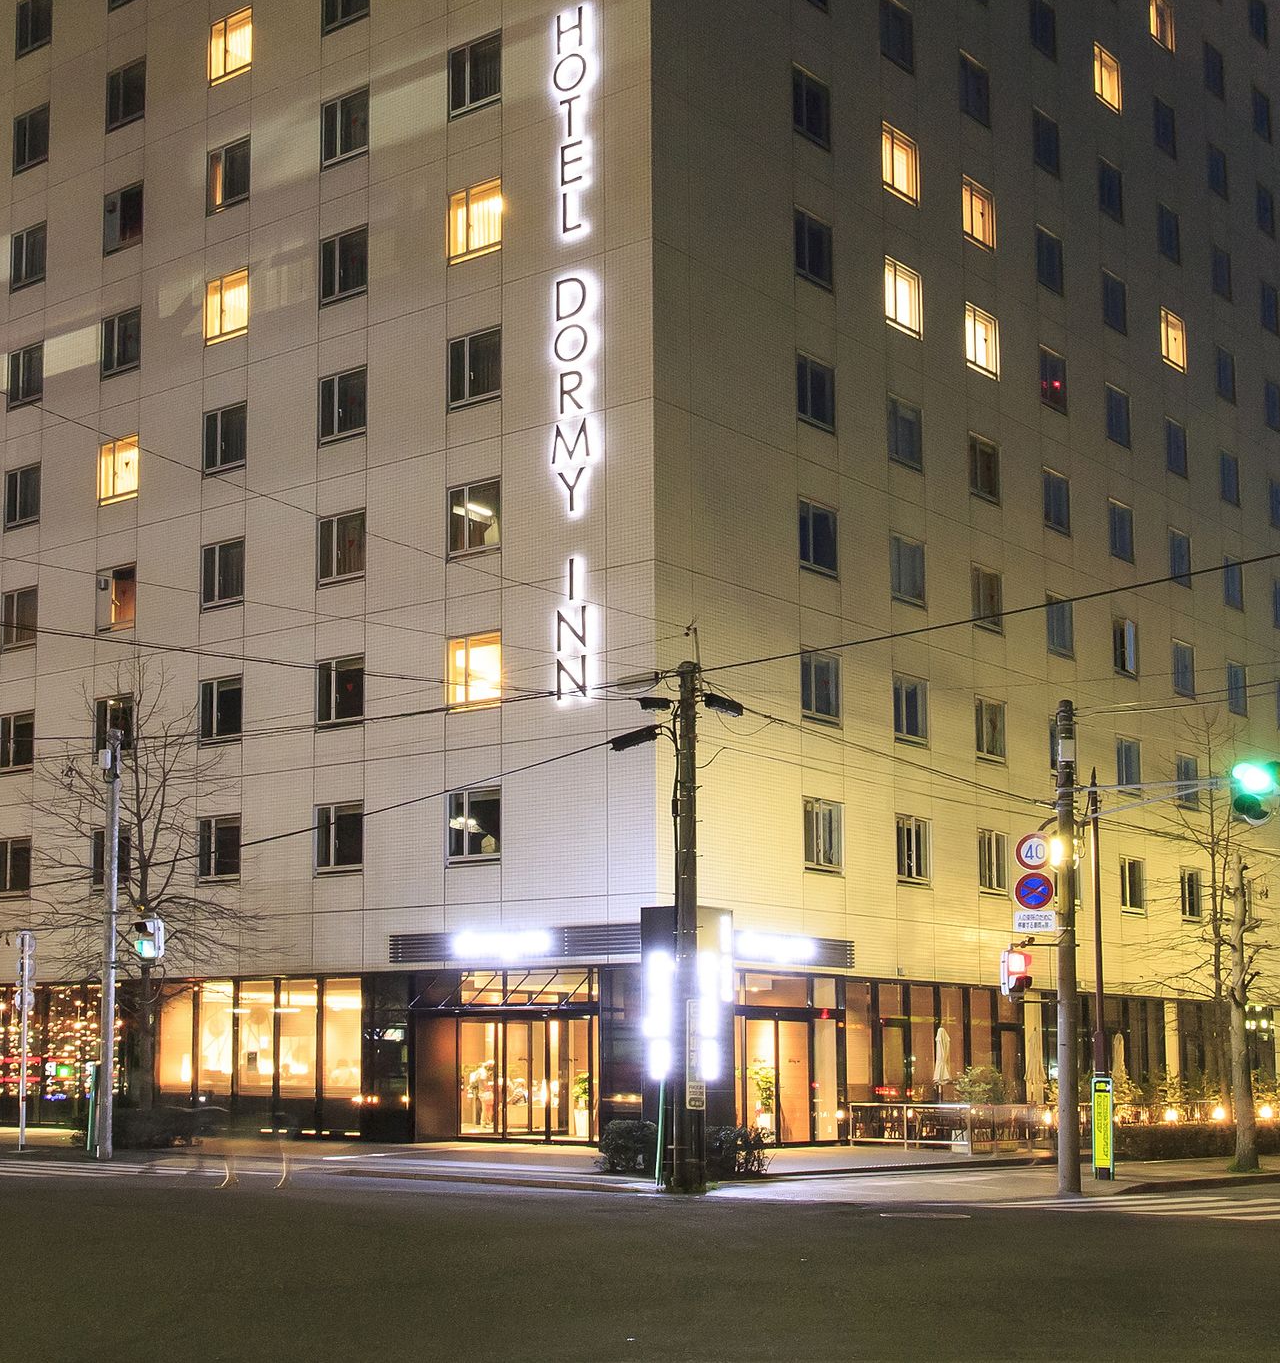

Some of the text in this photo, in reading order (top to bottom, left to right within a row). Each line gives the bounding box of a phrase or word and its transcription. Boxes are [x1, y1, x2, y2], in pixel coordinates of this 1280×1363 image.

[551, 5, 591, 703] HOTEL DORMY INN
[1024, 843, 1046, 860] 40
